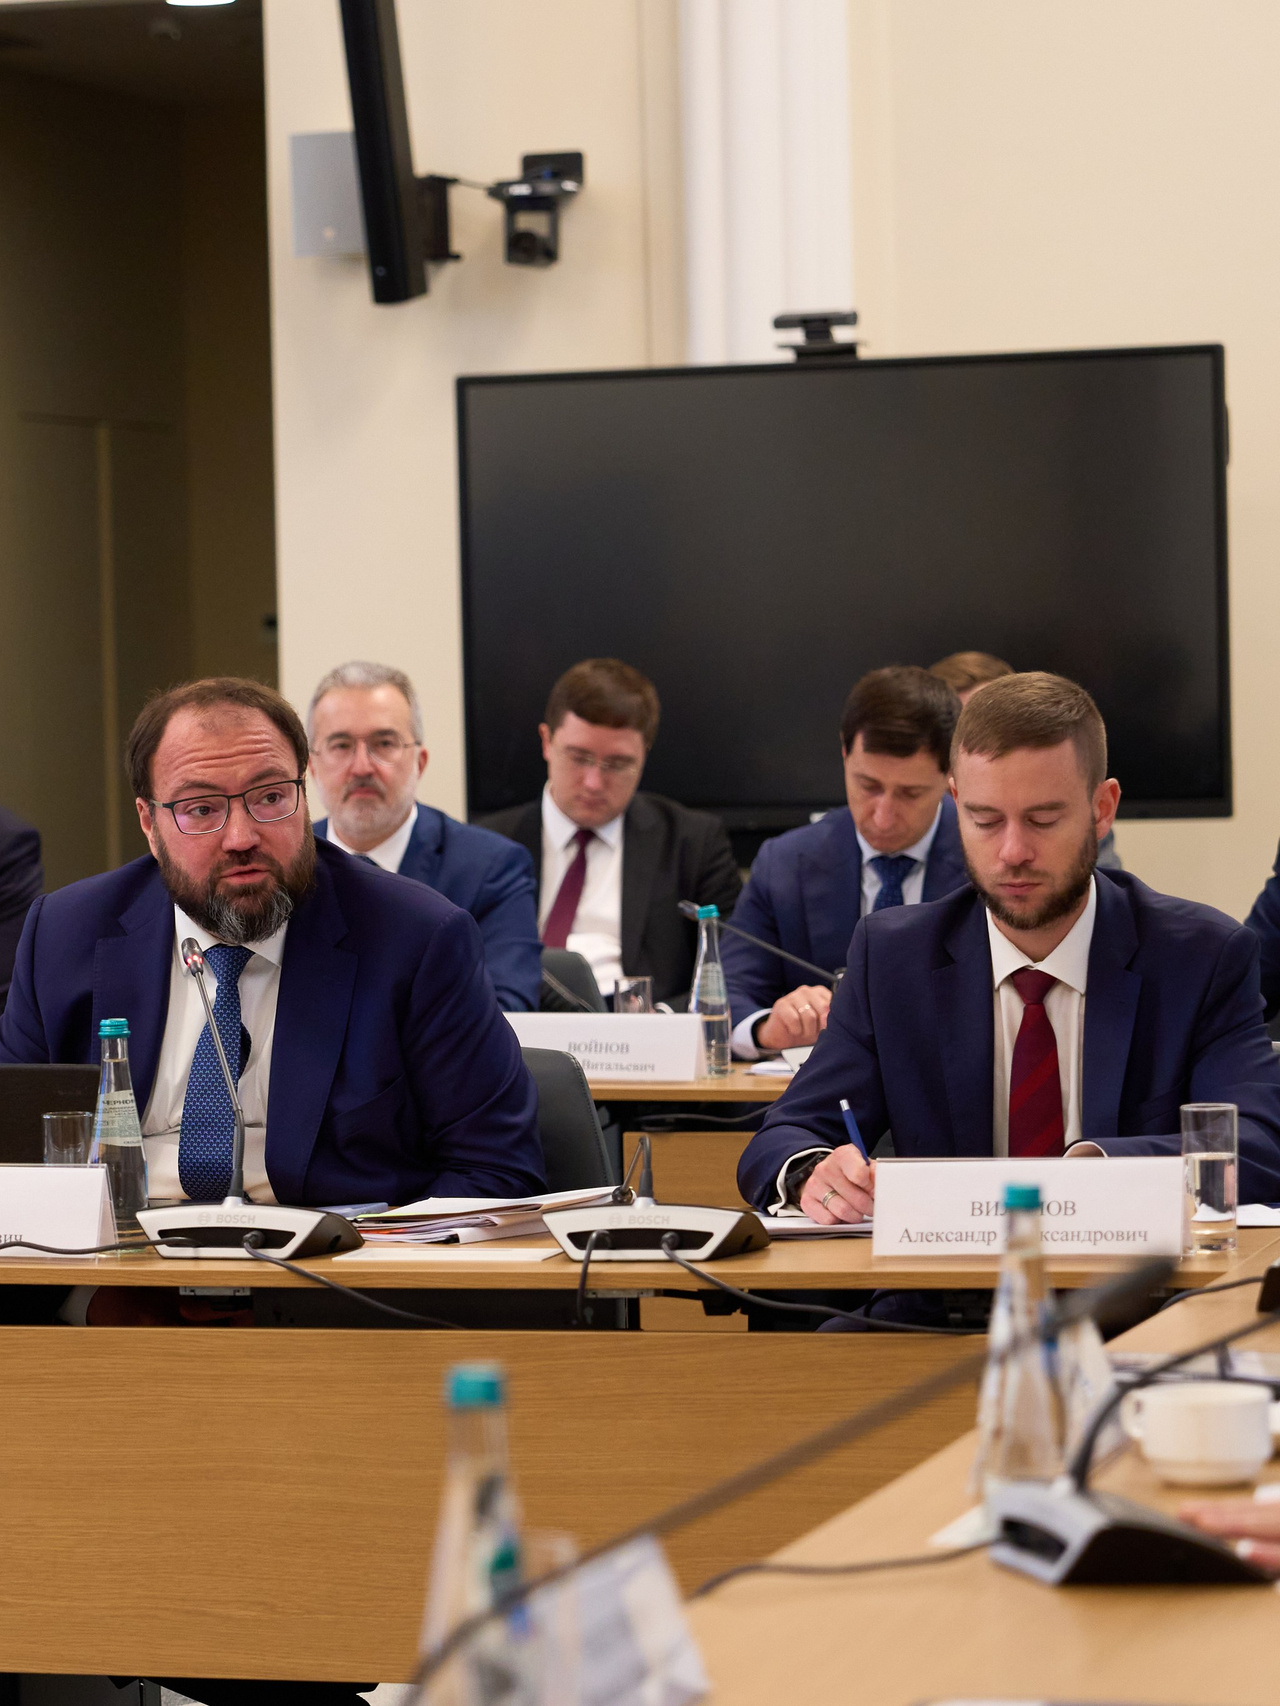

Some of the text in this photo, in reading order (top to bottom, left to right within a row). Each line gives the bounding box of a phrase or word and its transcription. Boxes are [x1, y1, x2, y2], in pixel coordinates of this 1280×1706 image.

[215, 1214, 256, 1224] BOSCH
[628, 1215, 670, 1225] BOSCH
[898, 1227, 1149, 1246] Александр ксандрович
